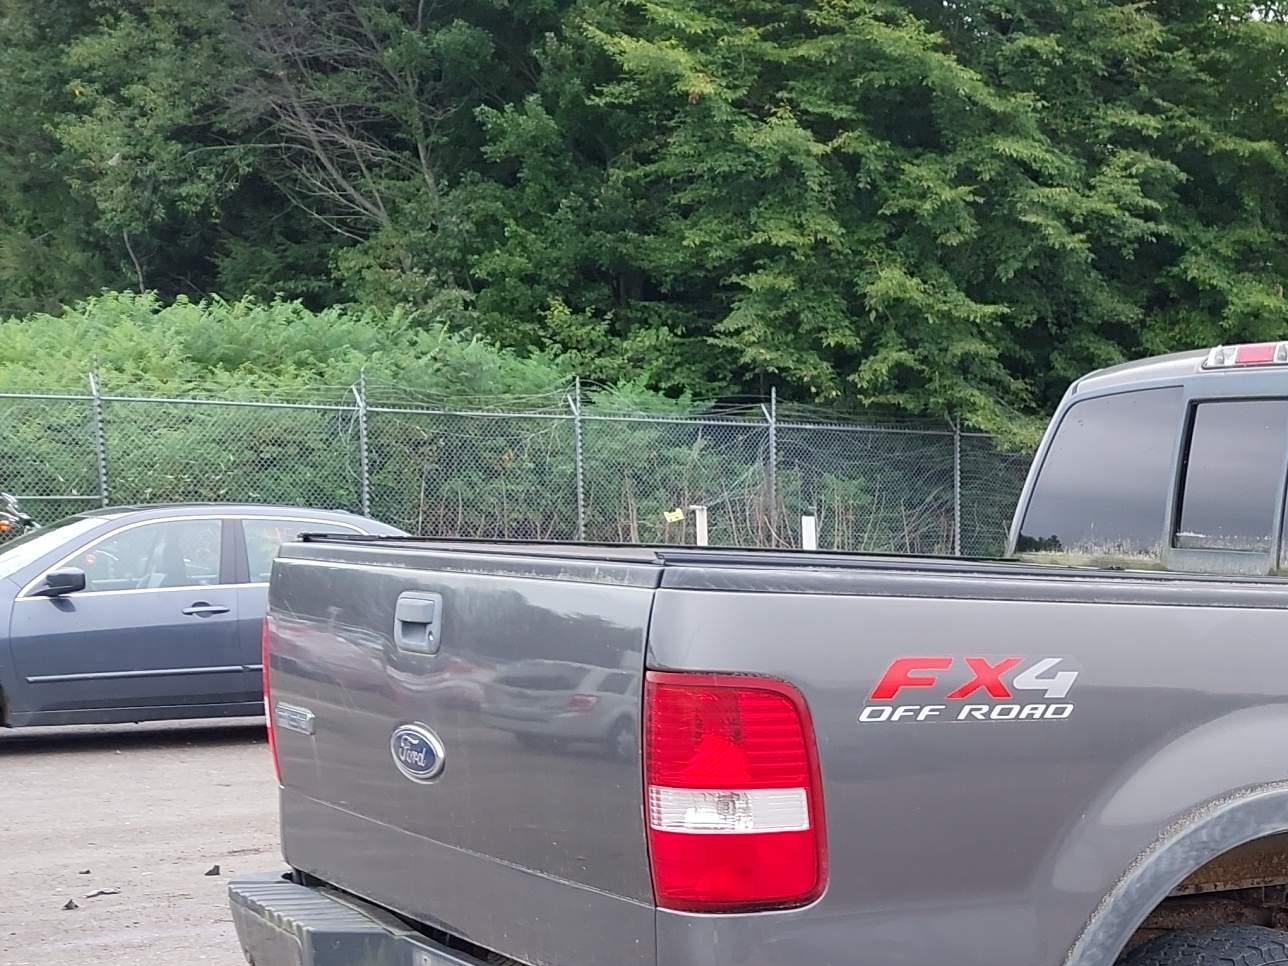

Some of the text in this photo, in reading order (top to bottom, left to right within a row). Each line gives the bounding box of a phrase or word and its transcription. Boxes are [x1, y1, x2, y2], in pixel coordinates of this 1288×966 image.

[868, 656, 1080, 701] FX4
[858, 703, 1075, 722] OFF ROAD
[398, 734, 427, 767] Ford
